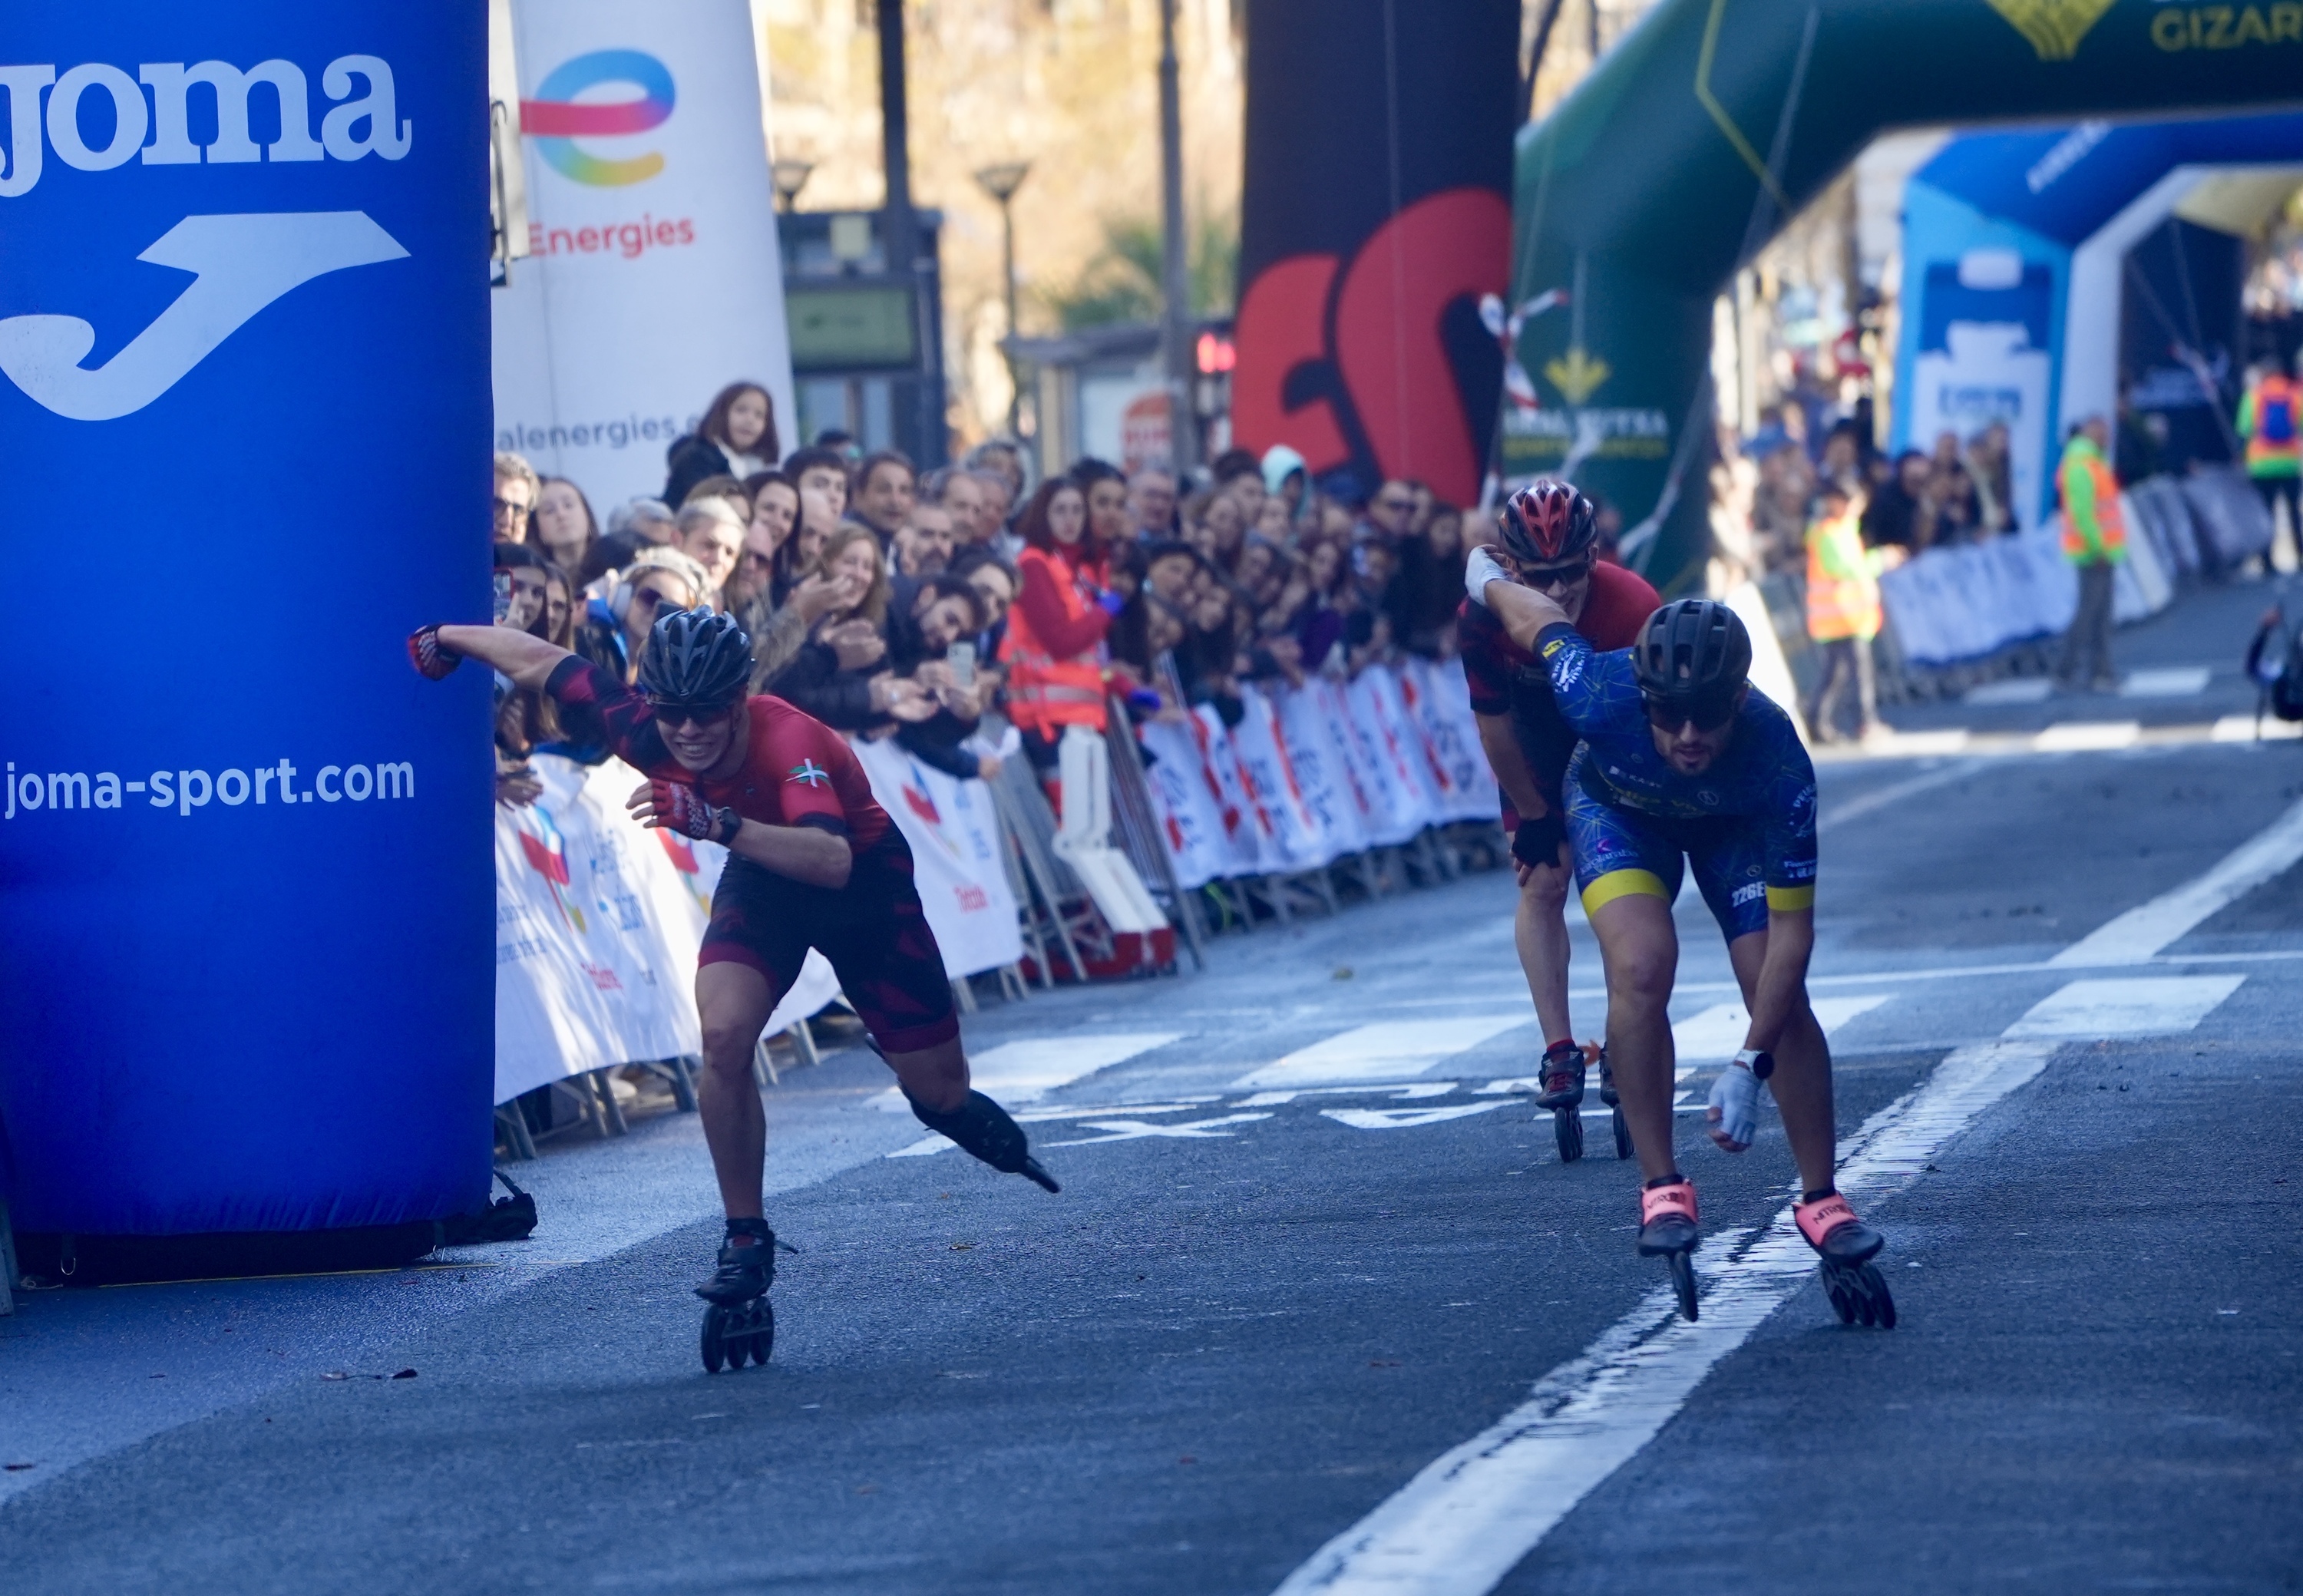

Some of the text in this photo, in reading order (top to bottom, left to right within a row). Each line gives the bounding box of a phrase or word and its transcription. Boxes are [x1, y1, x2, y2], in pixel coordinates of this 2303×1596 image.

[2150, 4, 2303, 51] GIZAR
[529, 213, 695, 259] Energies
[5, 758, 415, 819] joma-sport.com
